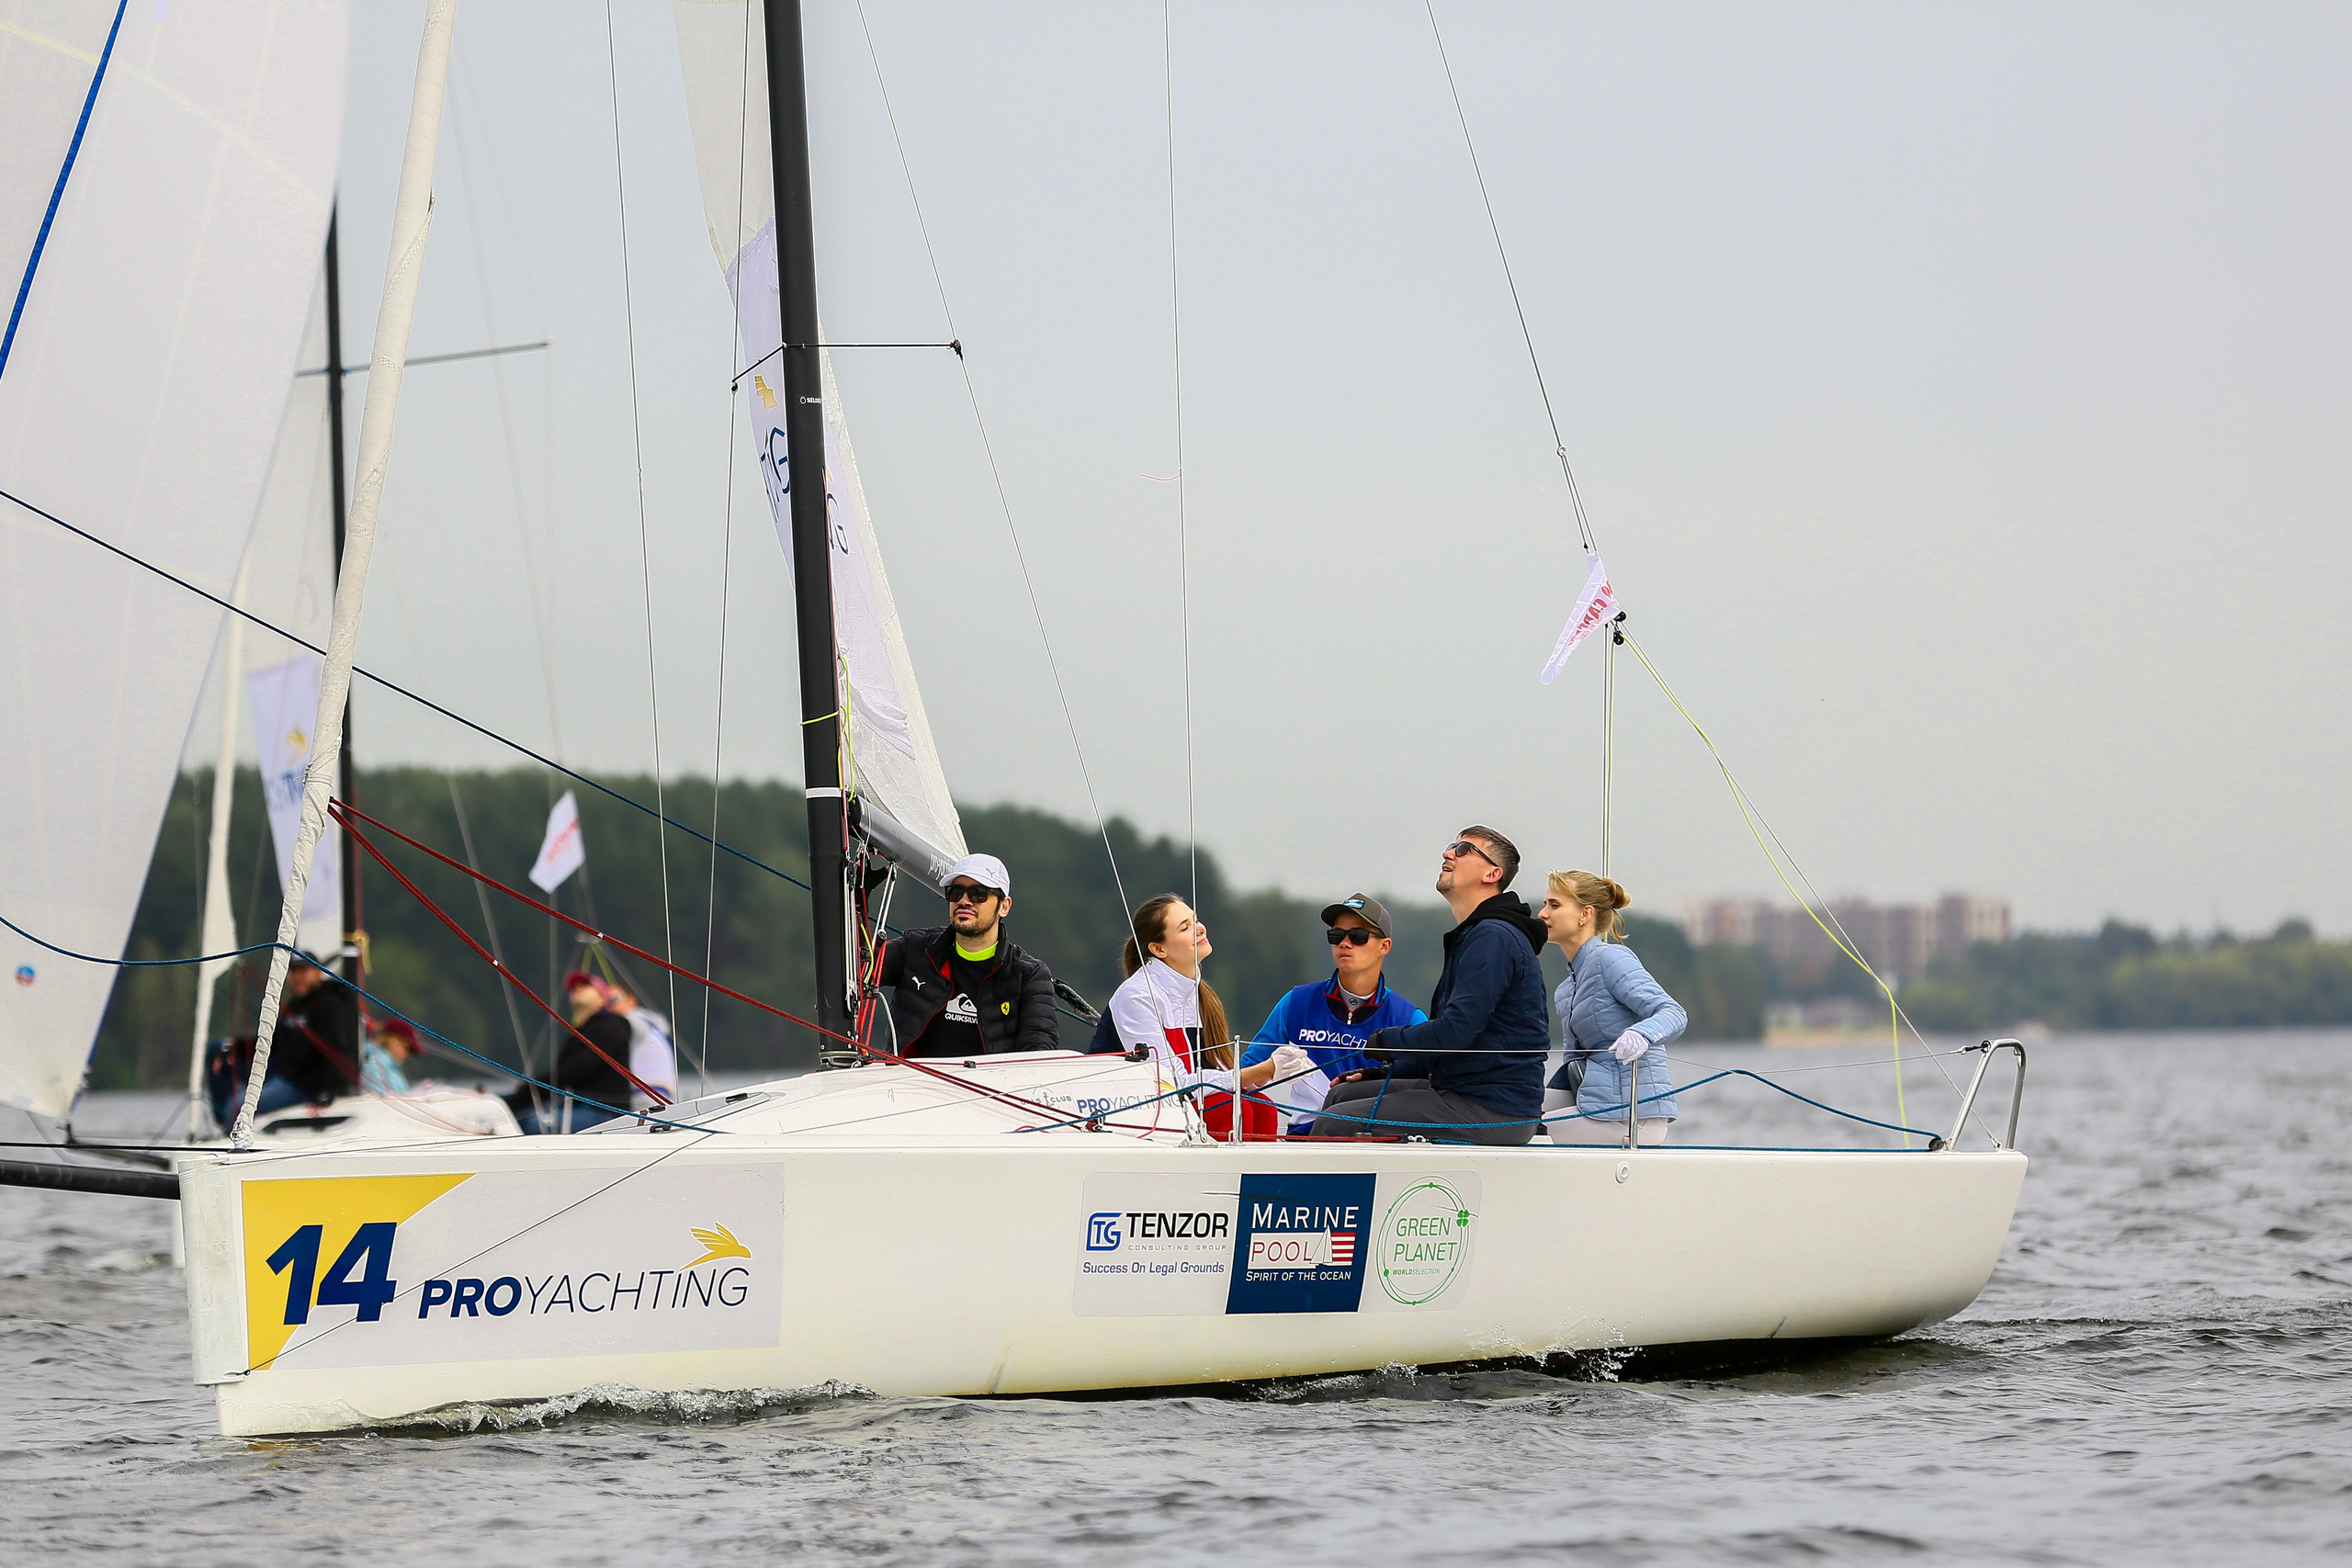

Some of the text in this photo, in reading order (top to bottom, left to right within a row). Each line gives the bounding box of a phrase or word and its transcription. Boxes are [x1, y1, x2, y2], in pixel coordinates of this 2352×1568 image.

[1076, 1094, 1182, 1113] PROYACHTNG
[1125, 1213, 1229, 1238] TENZOR
[1396, 1217, 1452, 1237] GREEN
[1250, 1241, 1313, 1262] POOL
[1393, 1242, 1458, 1262] PLANET
[265, 1222, 398, 1325] 14
[1082, 1261, 1225, 1276] Success On Legal Grounds
[1245, 1270, 1351, 1281] SPIRIT OF THE OCEAN
[417, 1267, 752, 1319] PROYACHTING
